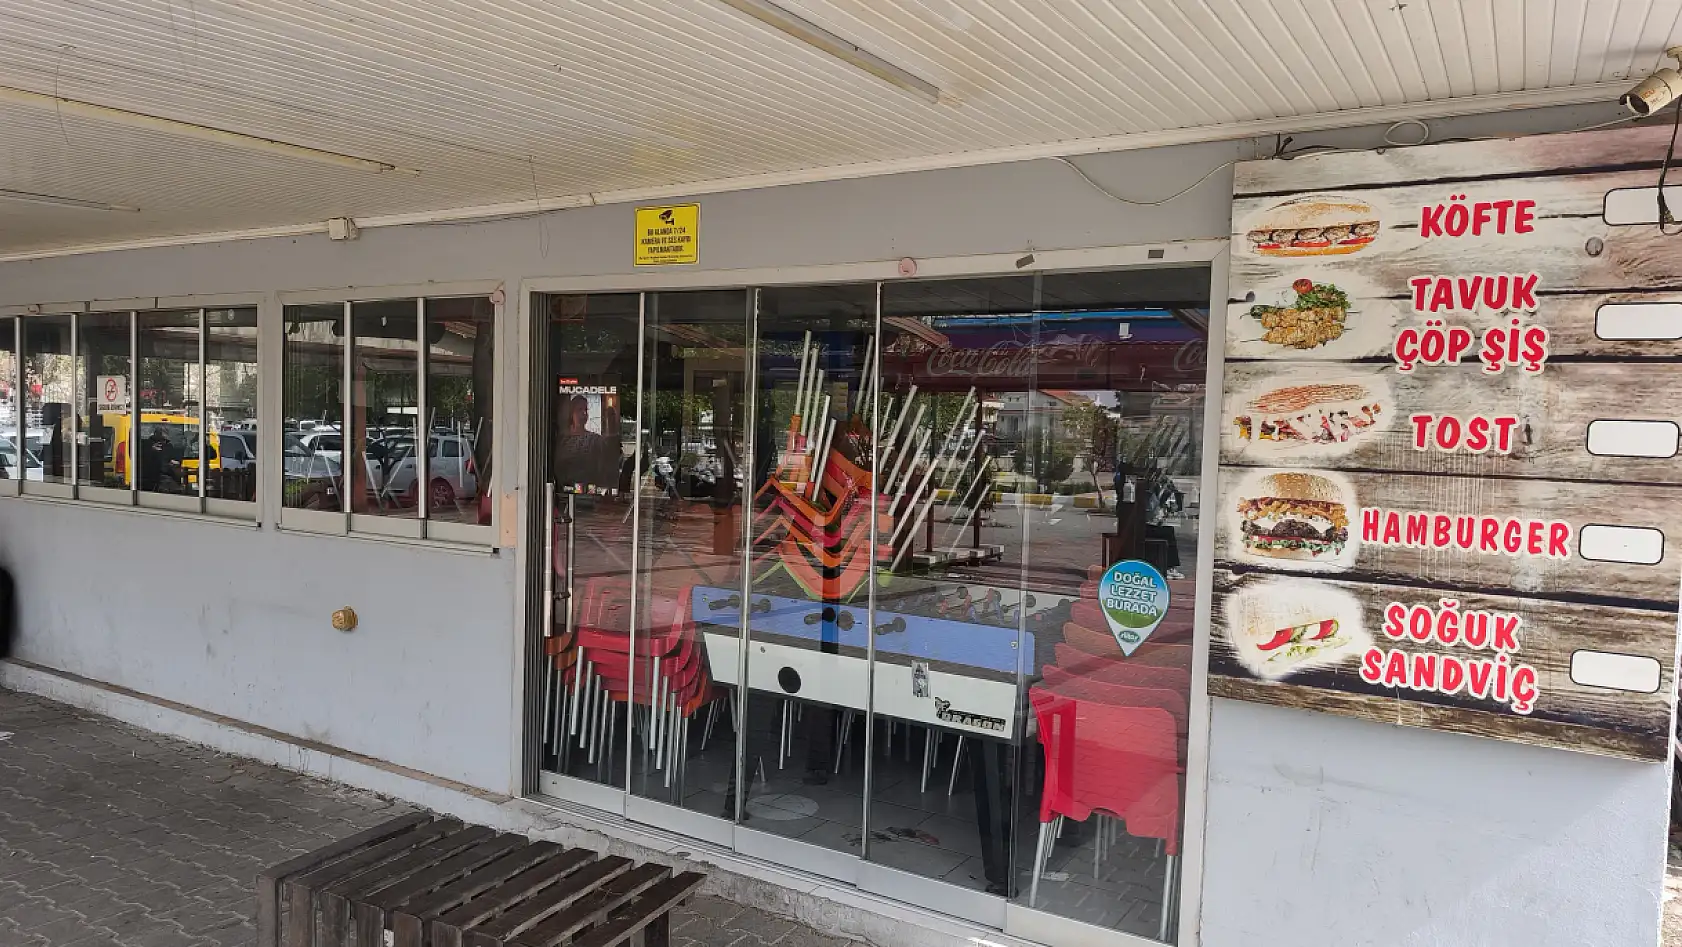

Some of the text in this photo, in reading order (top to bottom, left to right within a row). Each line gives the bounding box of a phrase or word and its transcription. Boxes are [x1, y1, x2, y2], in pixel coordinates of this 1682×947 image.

[1421, 194, 1536, 238] KÖFTE
[1411, 274, 1538, 312] TAVUK
[1395, 318, 1546, 372] ÇÖP ŞİŞ
[1412, 415, 1517, 451] TOST
[1362, 509, 1570, 556] HAMBURGER
[1111, 584, 1157, 602] LEZZET
[1114, 571, 1157, 588] DOĞAL
[1107, 599, 1157, 616] BURADA
[1385, 601, 1518, 649] SOĞUK
[1362, 649, 1535, 710] SANDVİÇ
